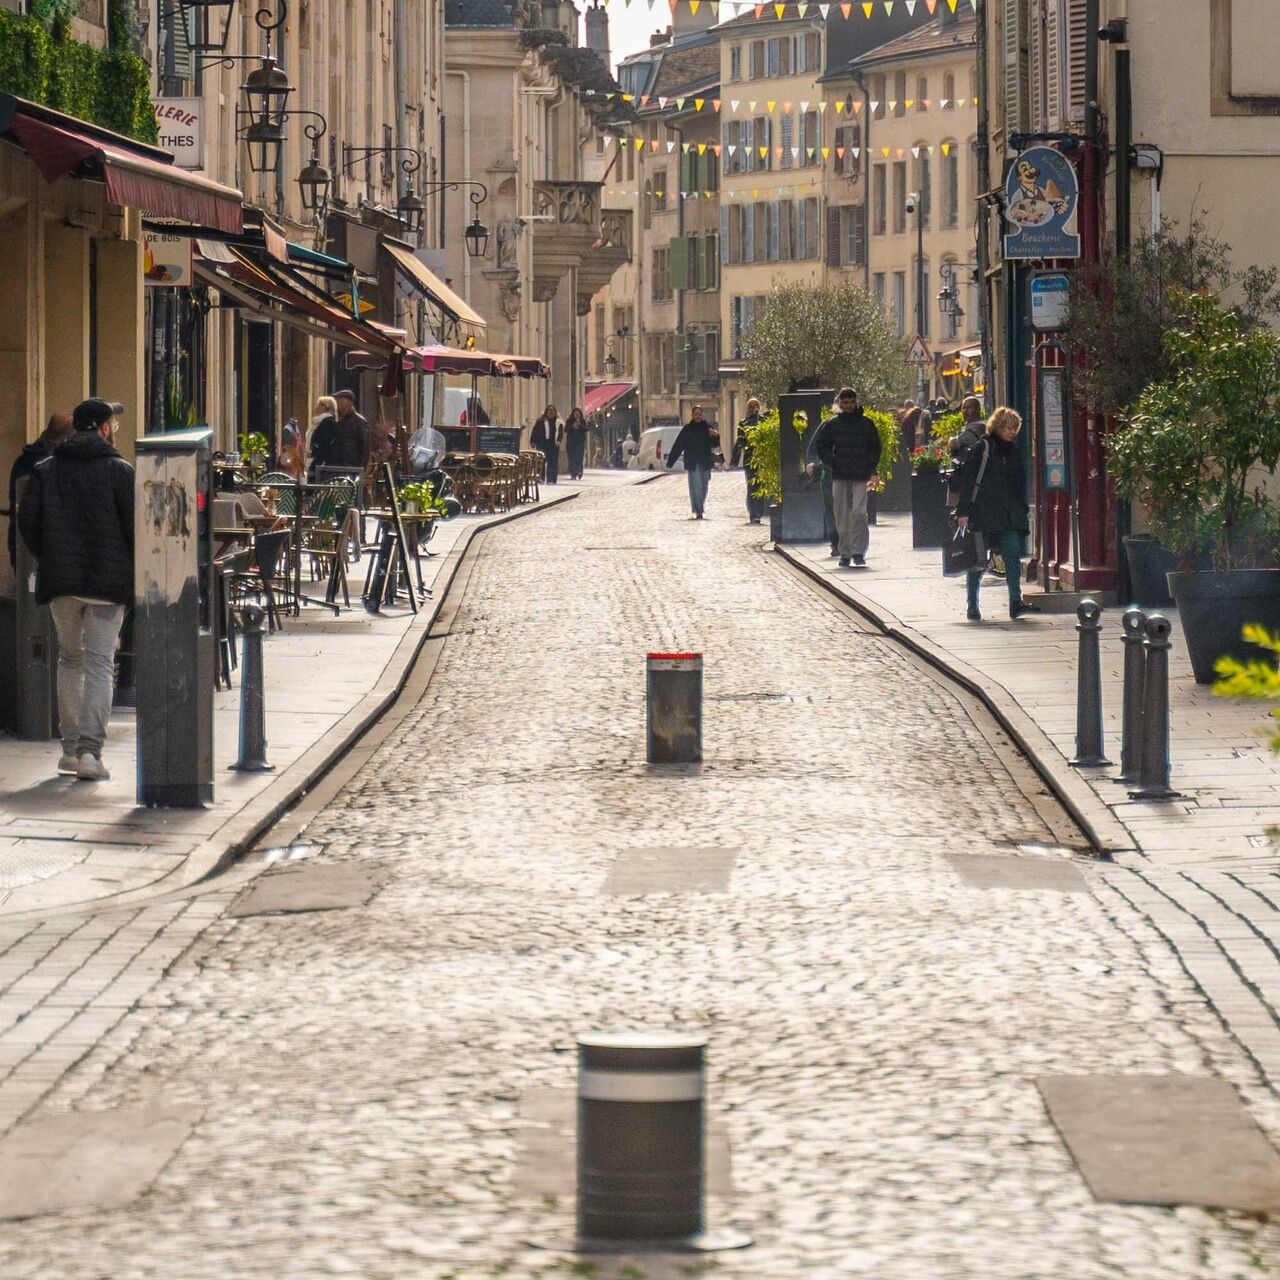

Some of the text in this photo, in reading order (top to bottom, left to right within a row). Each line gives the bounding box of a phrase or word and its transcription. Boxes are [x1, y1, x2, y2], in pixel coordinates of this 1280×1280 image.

[159, 135, 195, 147] THES
[147, 234, 181, 243] DE BOIS
